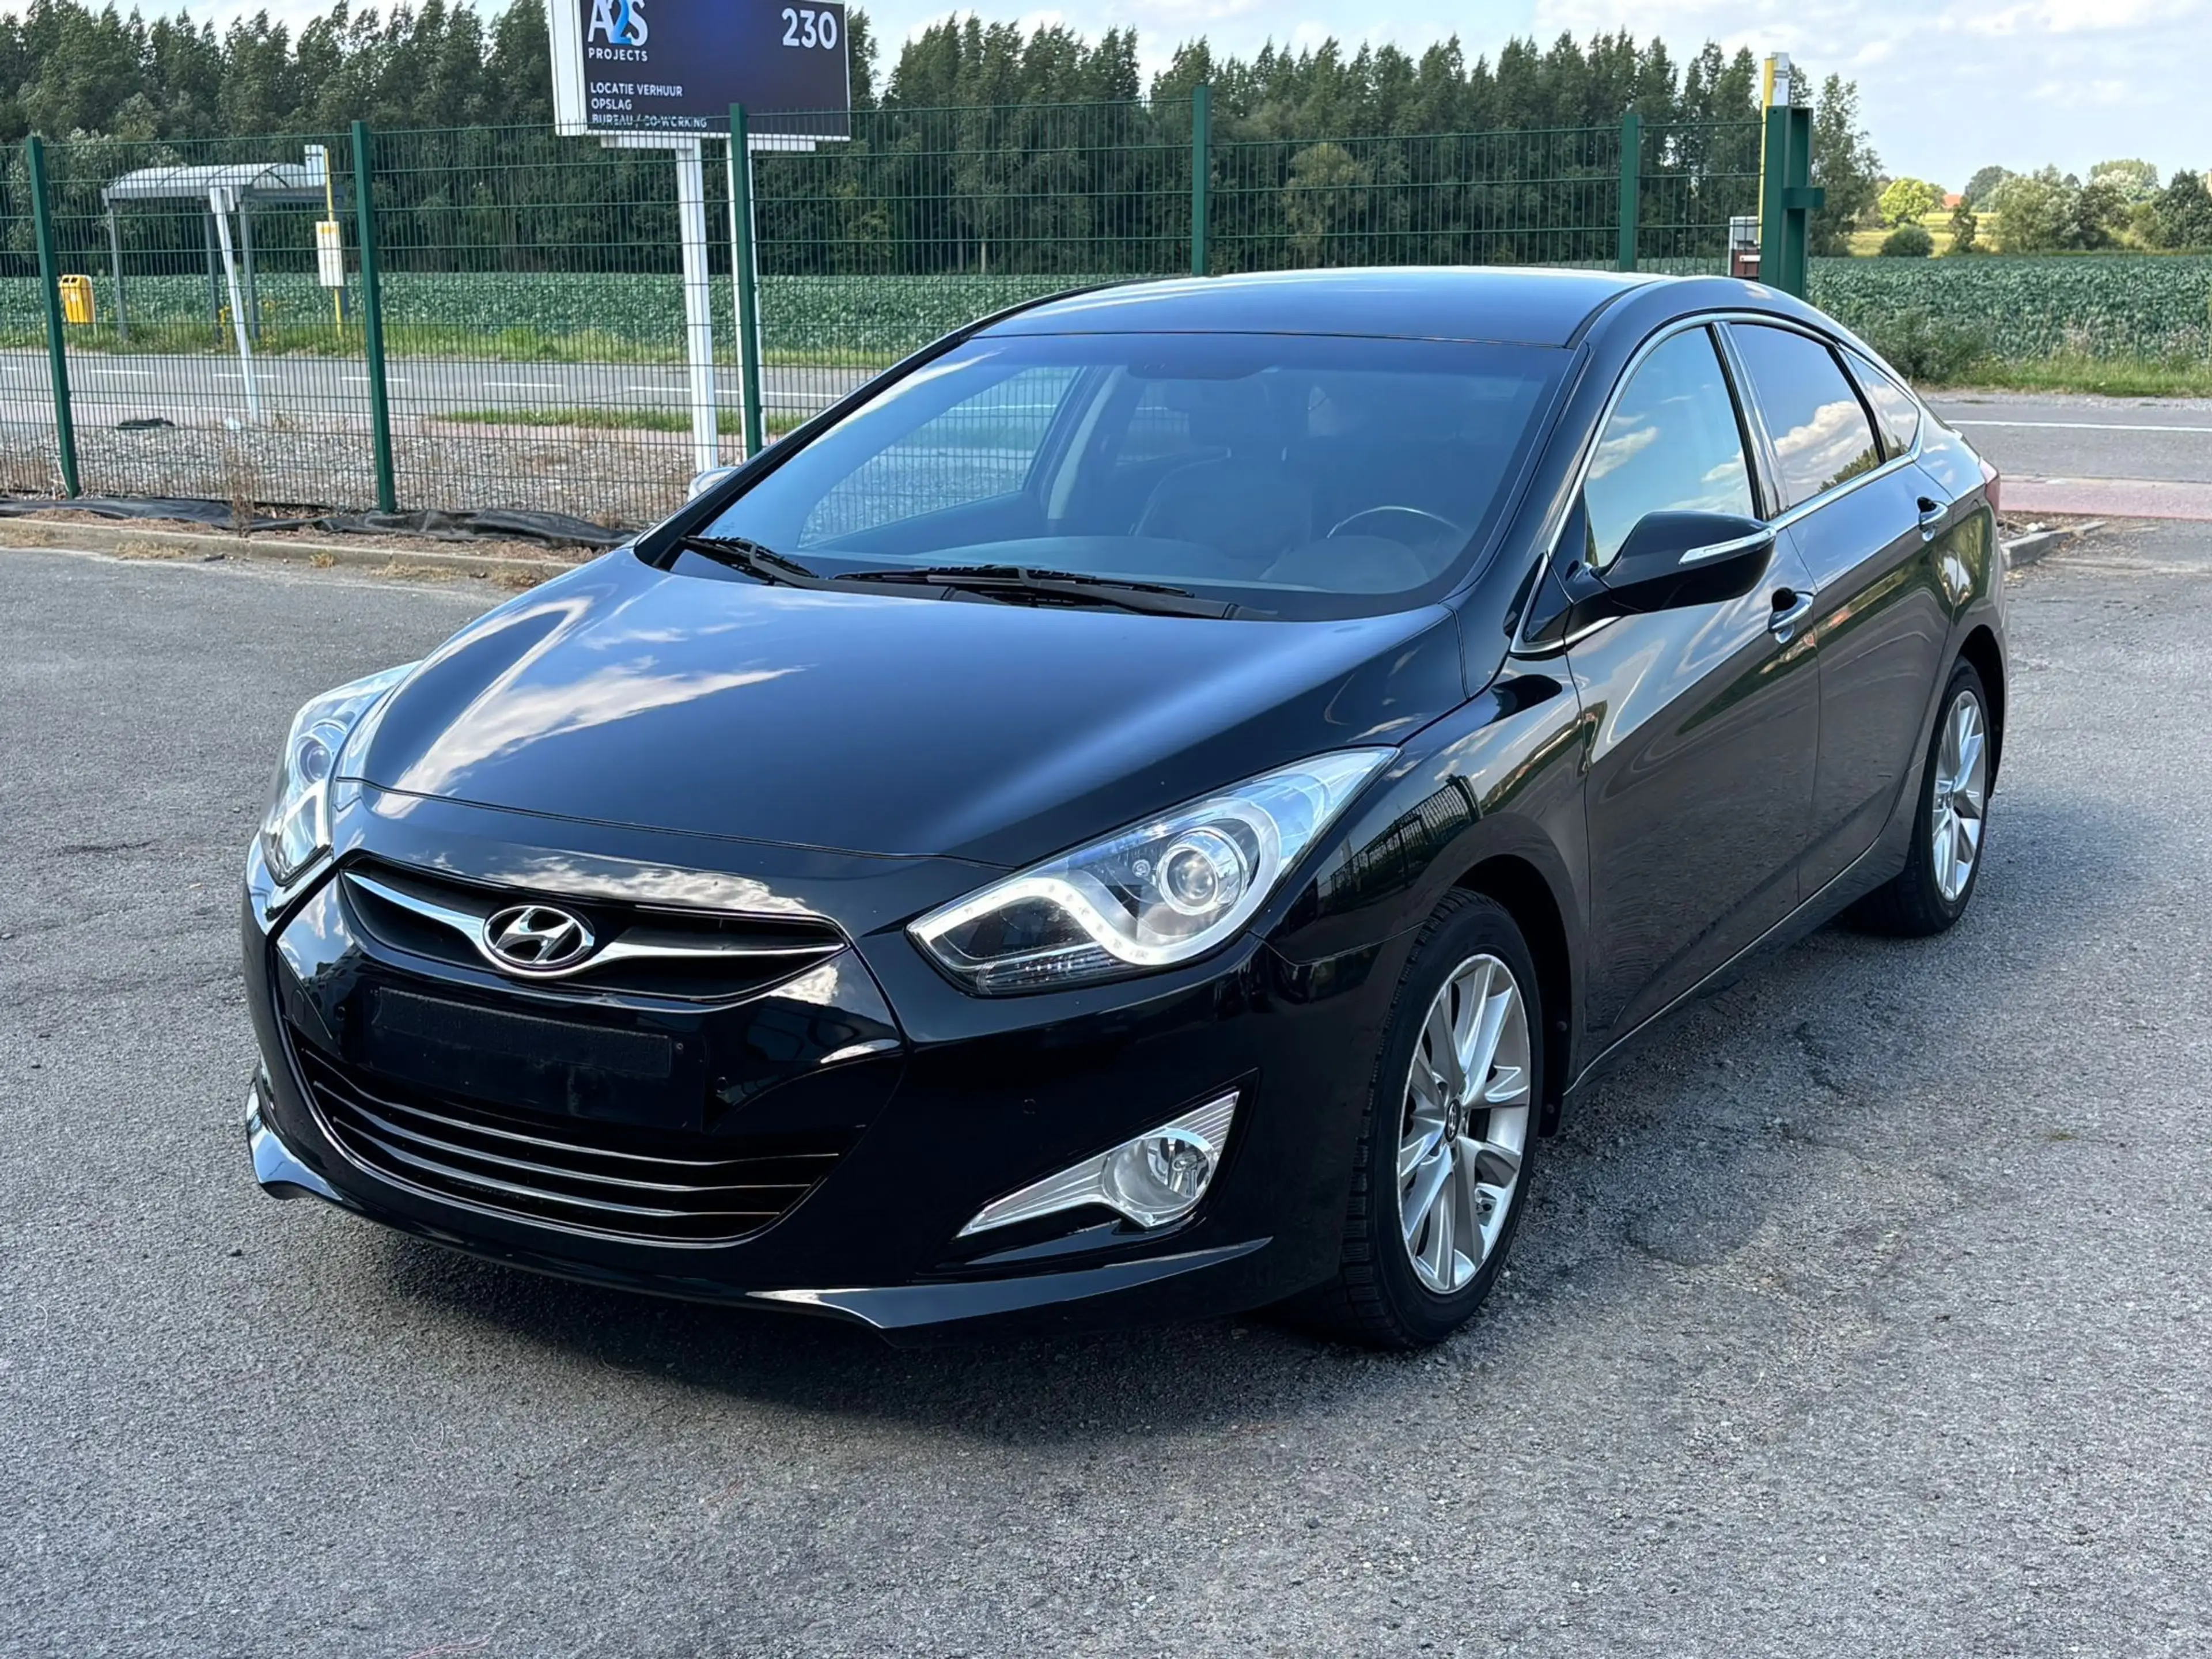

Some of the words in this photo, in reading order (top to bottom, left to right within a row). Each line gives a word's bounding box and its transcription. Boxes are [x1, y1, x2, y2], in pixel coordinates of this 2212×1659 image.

[588, 0, 648, 46] A2S
[782, 7, 837, 50] 230
[588, 47, 647, 62] PROJECTS
[590, 82, 634, 95] LOCATIE
[637, 84, 683, 97] VERHUUR
[591, 99, 632, 111] OPSLAG
[592, 113, 633, 126] BUREAU
[645, 115, 707, 128] CO-WORKNG
